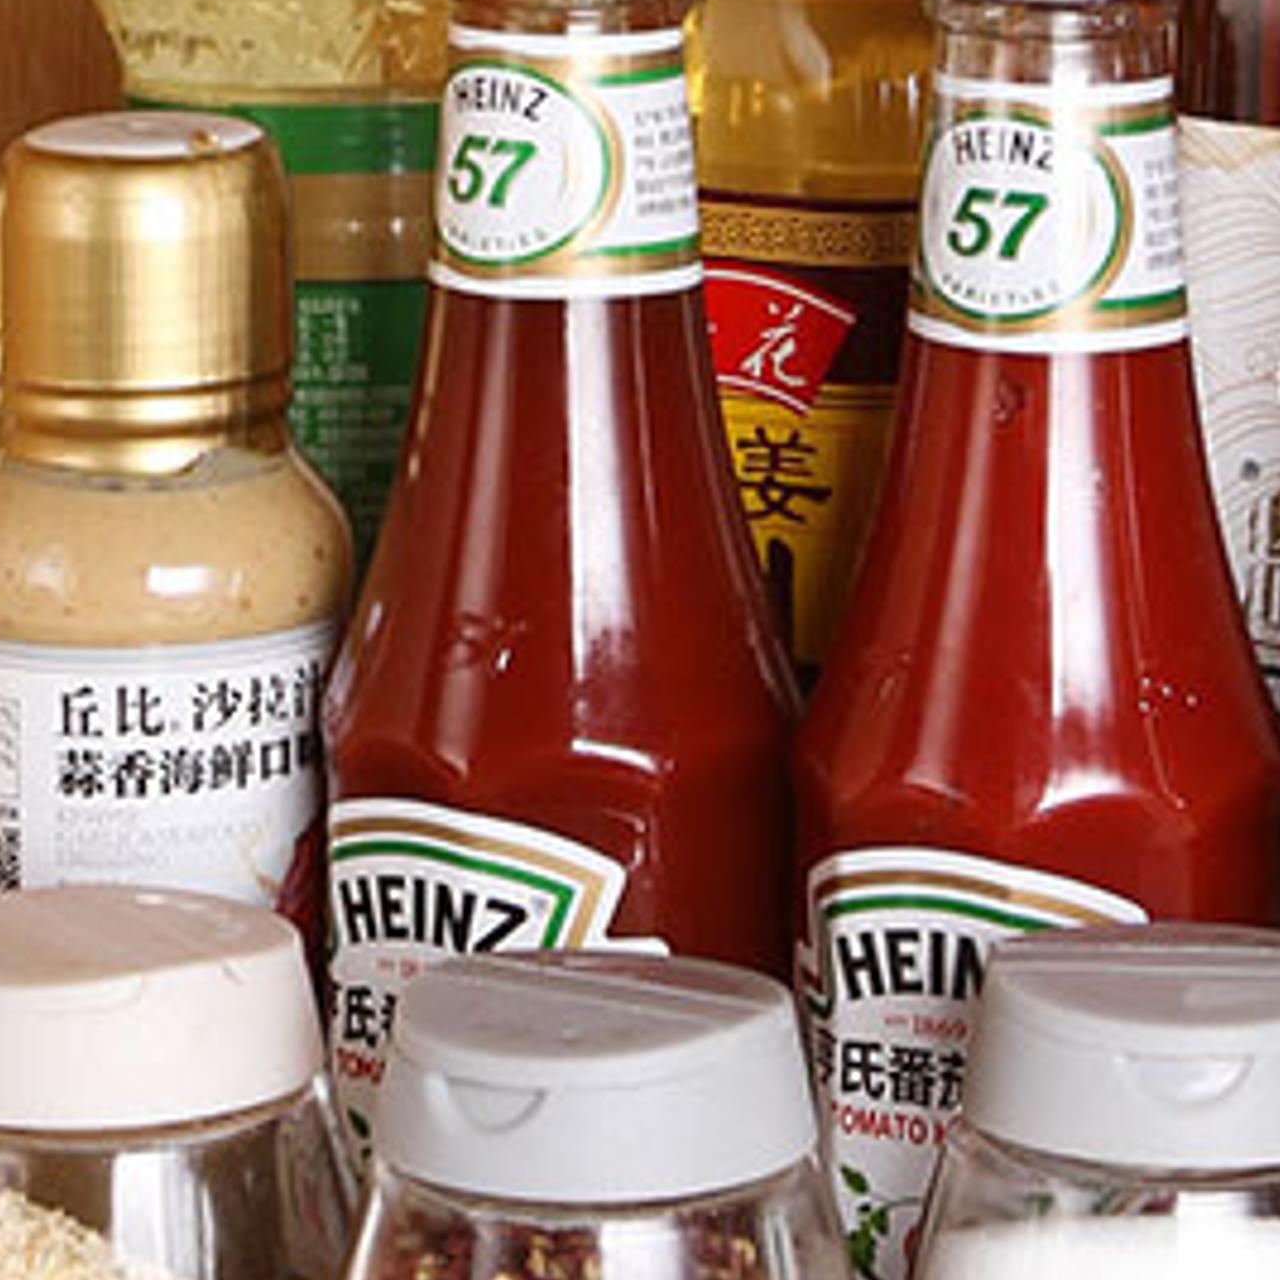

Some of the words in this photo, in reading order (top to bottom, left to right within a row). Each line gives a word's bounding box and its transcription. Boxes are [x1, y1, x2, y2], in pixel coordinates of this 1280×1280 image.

[452, 75, 549, 122] HEINZ
[447, 134, 538, 209] 57
[952, 125, 1056, 171] HEINZ
[946, 186, 1050, 260] 57
[734, 426, 834, 525] 姜
[338, 874, 530, 954] HEINZ
[836, 927, 987, 1001] HEIN
